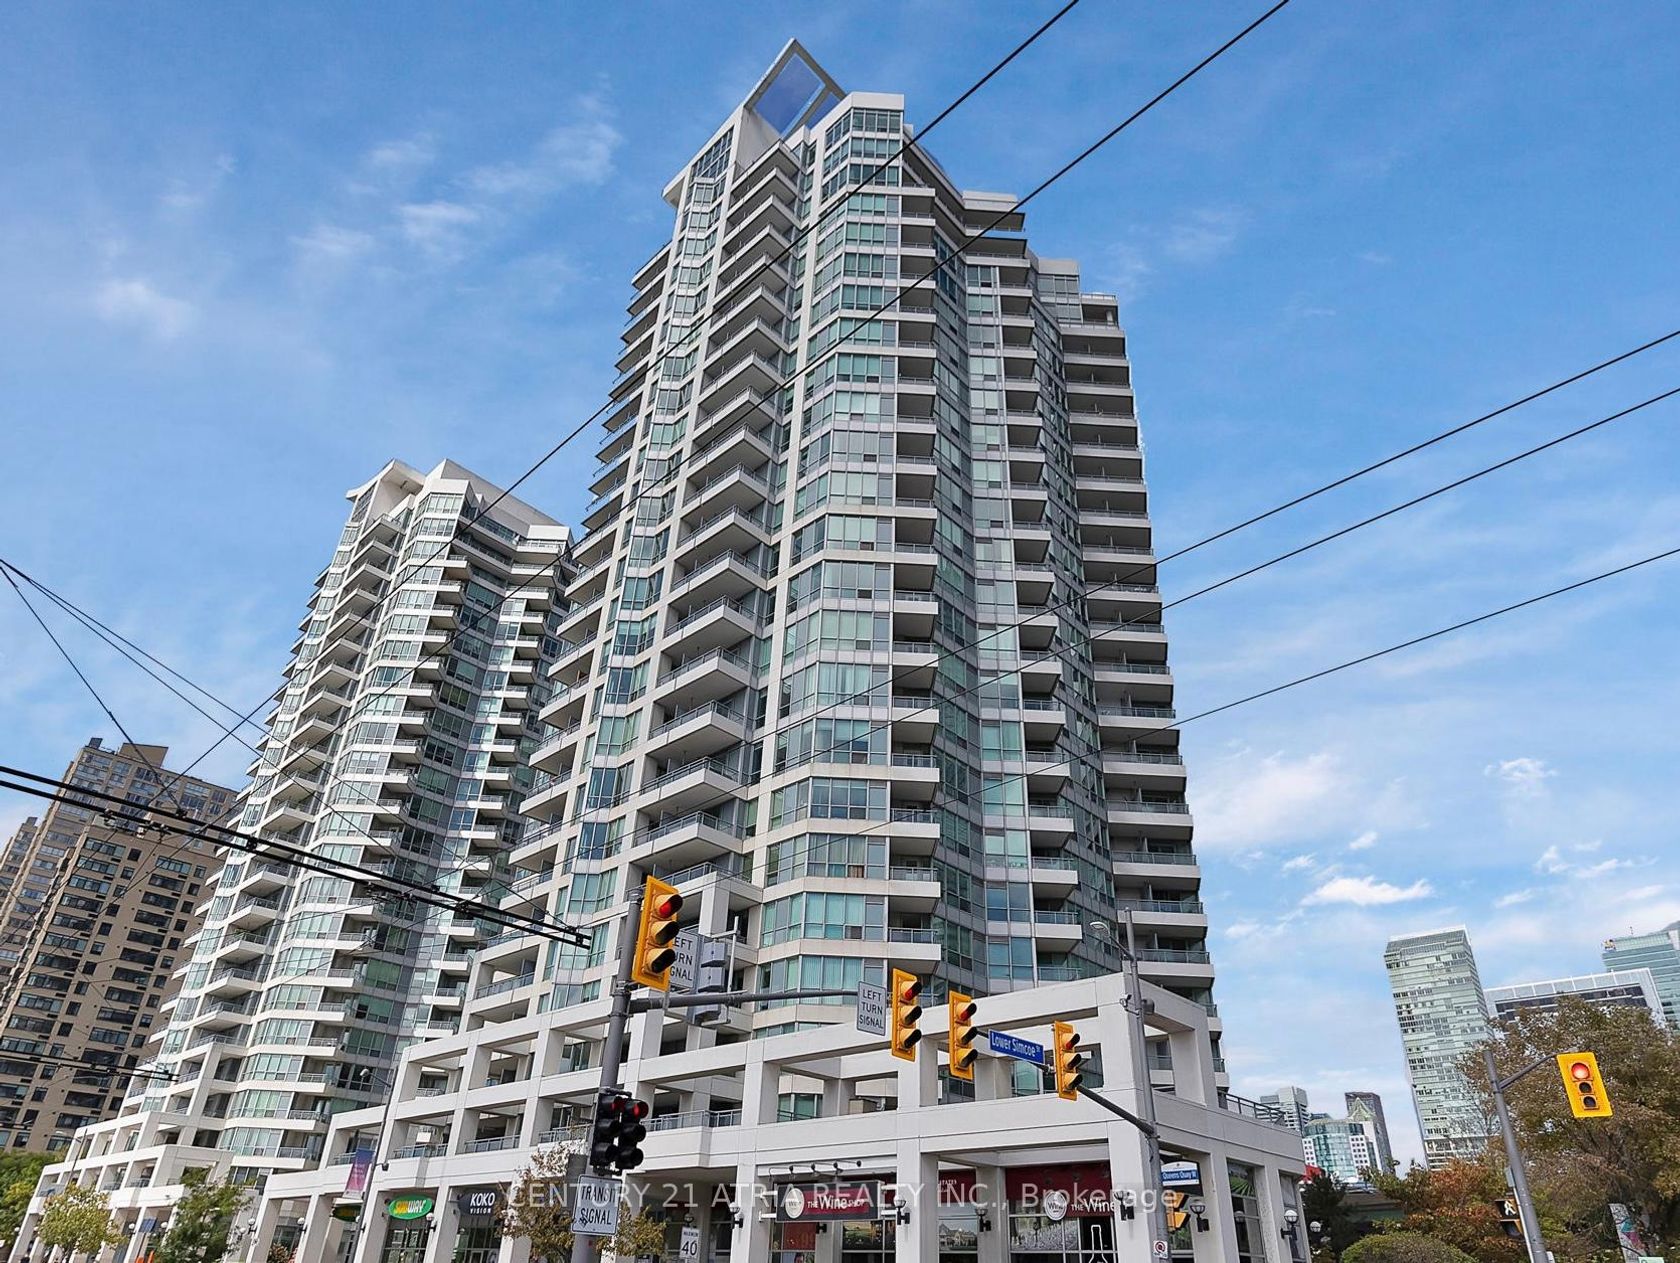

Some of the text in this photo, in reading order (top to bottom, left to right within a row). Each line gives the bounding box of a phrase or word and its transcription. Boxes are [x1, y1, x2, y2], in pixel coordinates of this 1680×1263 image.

[674, 936, 693, 950] EFT
[670, 966, 692, 981] GNAL
[862, 989, 881, 1001] LEFT
[861, 1002, 883, 1015] TURN
[859, 1014, 883, 1029] SIGNAL
[991, 1032, 1011, 1050] Lower
[1012, 1038, 1036, 1057] Simcoe
[470, 1192, 495, 1207] KOKO
[581, 1185, 616, 1203] TRANSIT
[394, 1200, 427, 1214] SUBWAY
[818, 1194, 847, 1210] Wine
[847, 1199, 865, 1207] SHOP
[1083, 1198, 1115, 1213] Wine
[580, 1208, 612, 1225] SIGNAL
[682, 1240, 698, 1256] 40
